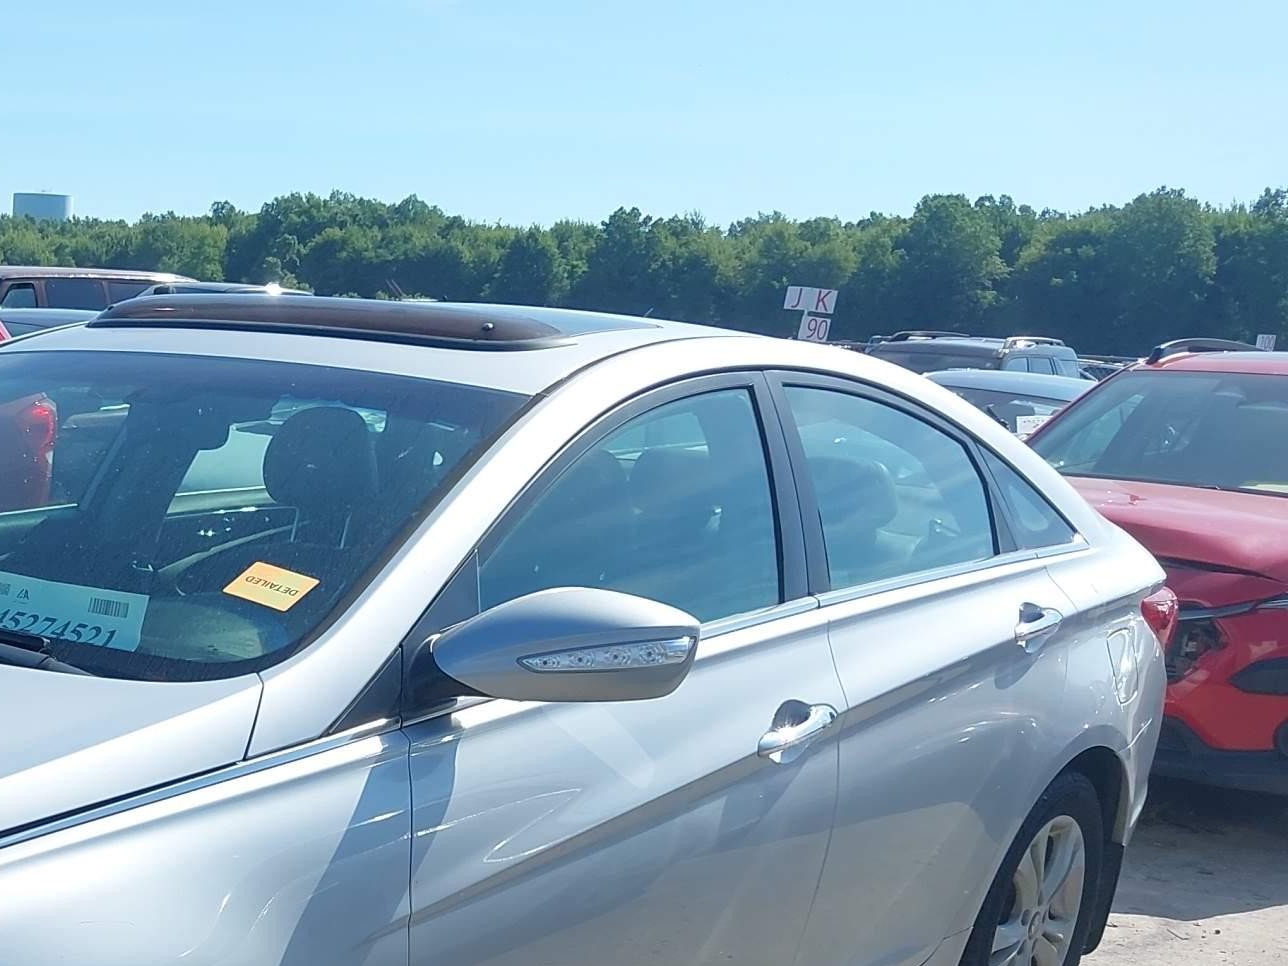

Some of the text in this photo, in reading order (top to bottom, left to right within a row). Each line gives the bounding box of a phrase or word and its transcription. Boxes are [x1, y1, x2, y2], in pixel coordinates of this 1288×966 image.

[790, 287, 833, 312] J K
[805, 318, 829, 341] 90
[245, 575, 300, 597] DETAILED
